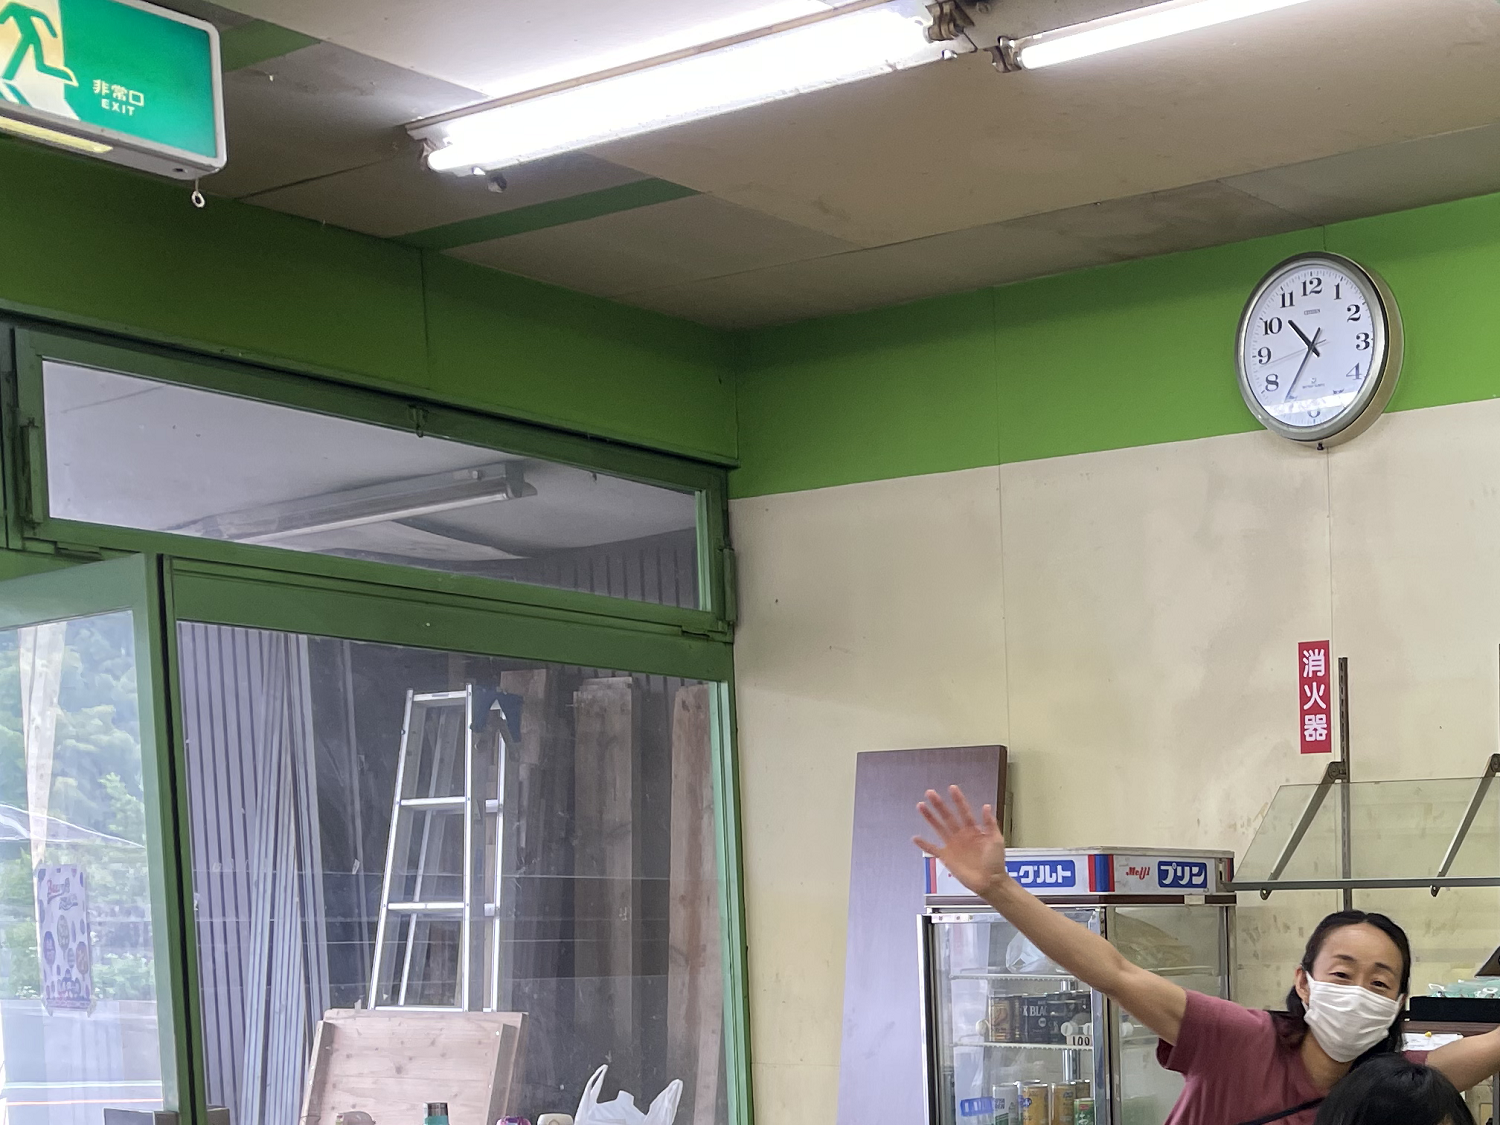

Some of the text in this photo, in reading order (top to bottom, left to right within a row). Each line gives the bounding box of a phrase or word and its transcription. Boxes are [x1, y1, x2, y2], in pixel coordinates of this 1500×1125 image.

[93, 79, 144, 107] 非常口
[101, 99, 135, 116] EXIT
[1301, 277, 1323, 297] 12
[1334, 283, 1342, 300] 1
[1280, 291, 1294, 308] 11
[1347, 304, 1361, 322] 2
[1263, 317, 1282, 335] 10
[1356, 333, 1370, 350] 3
[1257, 347, 1271, 364] 9
[1346, 363, 1362, 380] 4
[1265, 374, 1279, 391] 8
[1302, 648, 1327, 742] 消火器
[1005, 865, 1072, 884] ーグルト
[1160, 862, 1205, 886] プリン
[1072, 1036, 1090, 1046] 100
